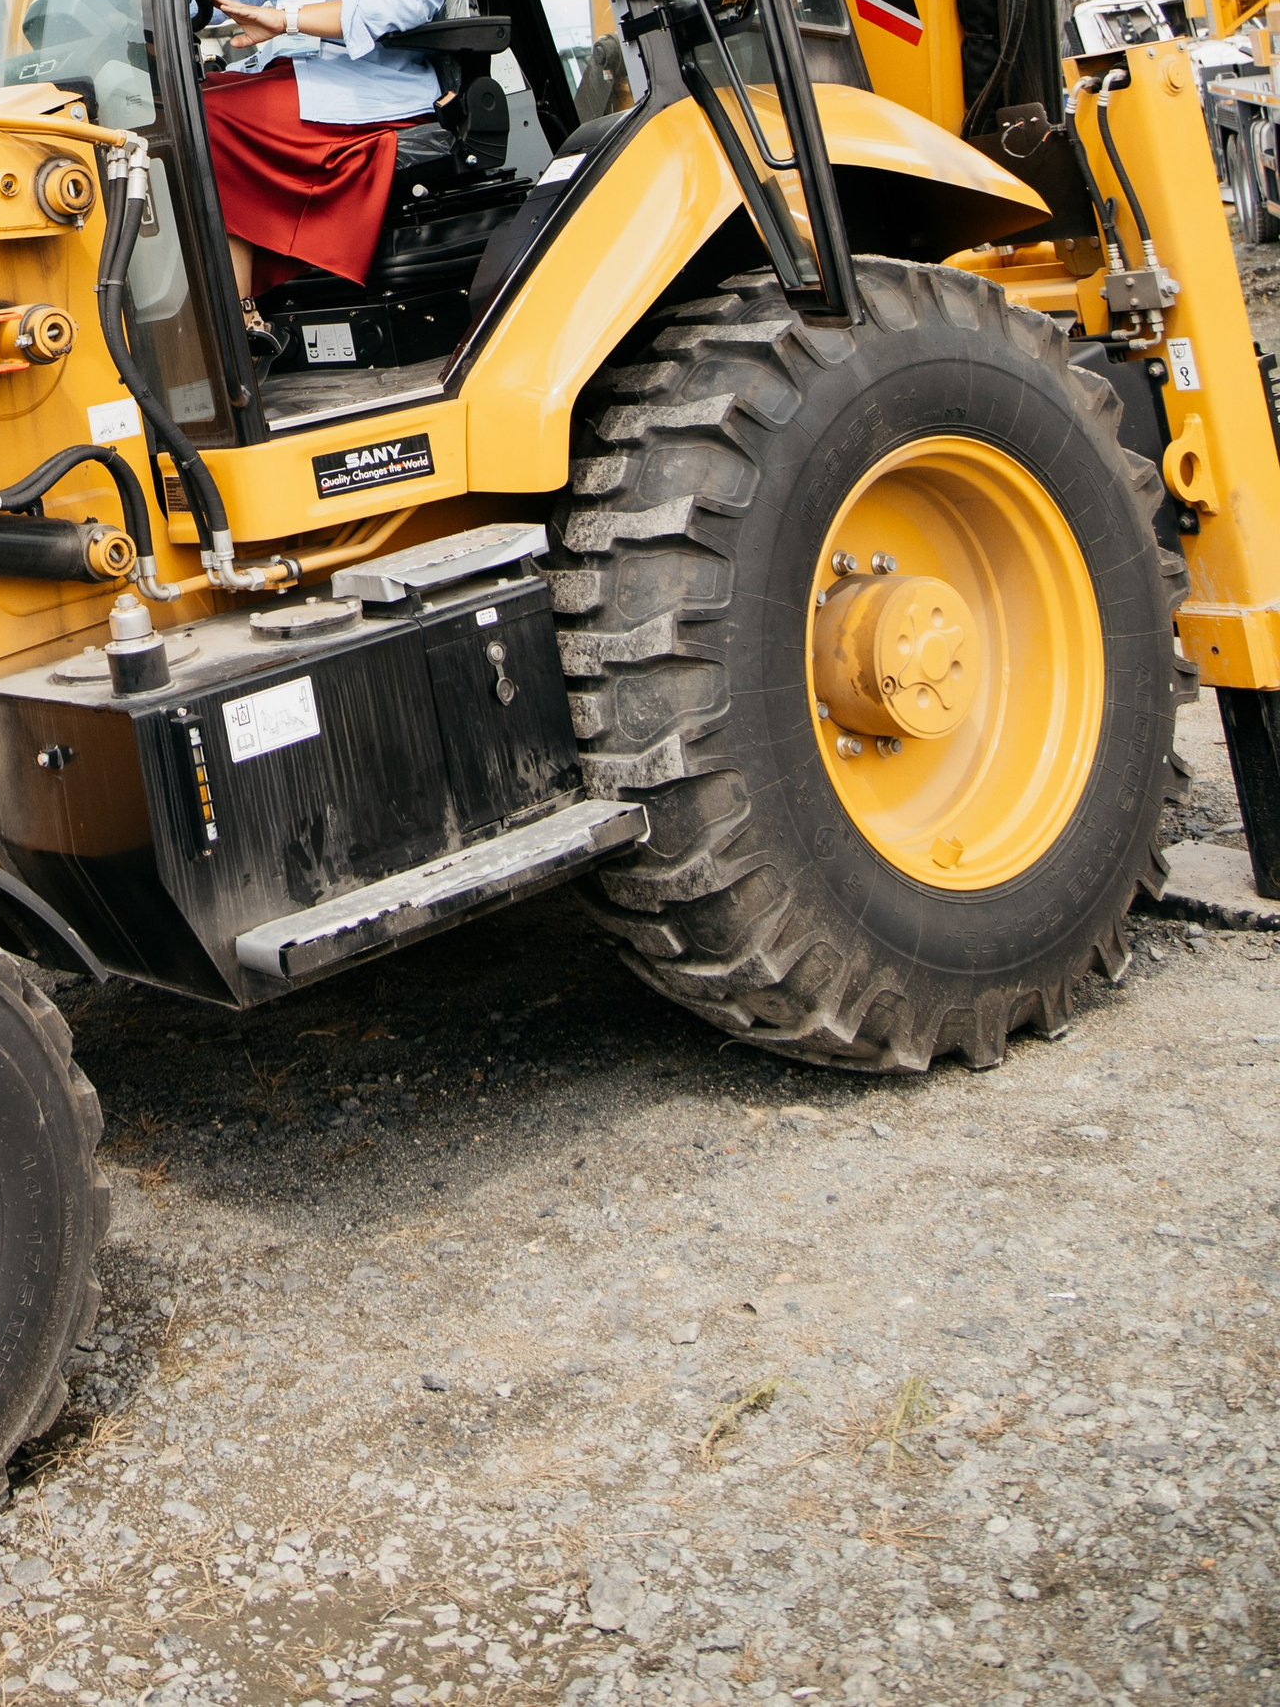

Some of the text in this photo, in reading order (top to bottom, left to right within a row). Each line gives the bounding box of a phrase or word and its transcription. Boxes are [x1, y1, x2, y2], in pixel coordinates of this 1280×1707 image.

[321, 455, 429, 487] Quality Changes the World
[344, 443, 402, 469] SANY
[1115, 660, 1152, 813] AEOLUS
